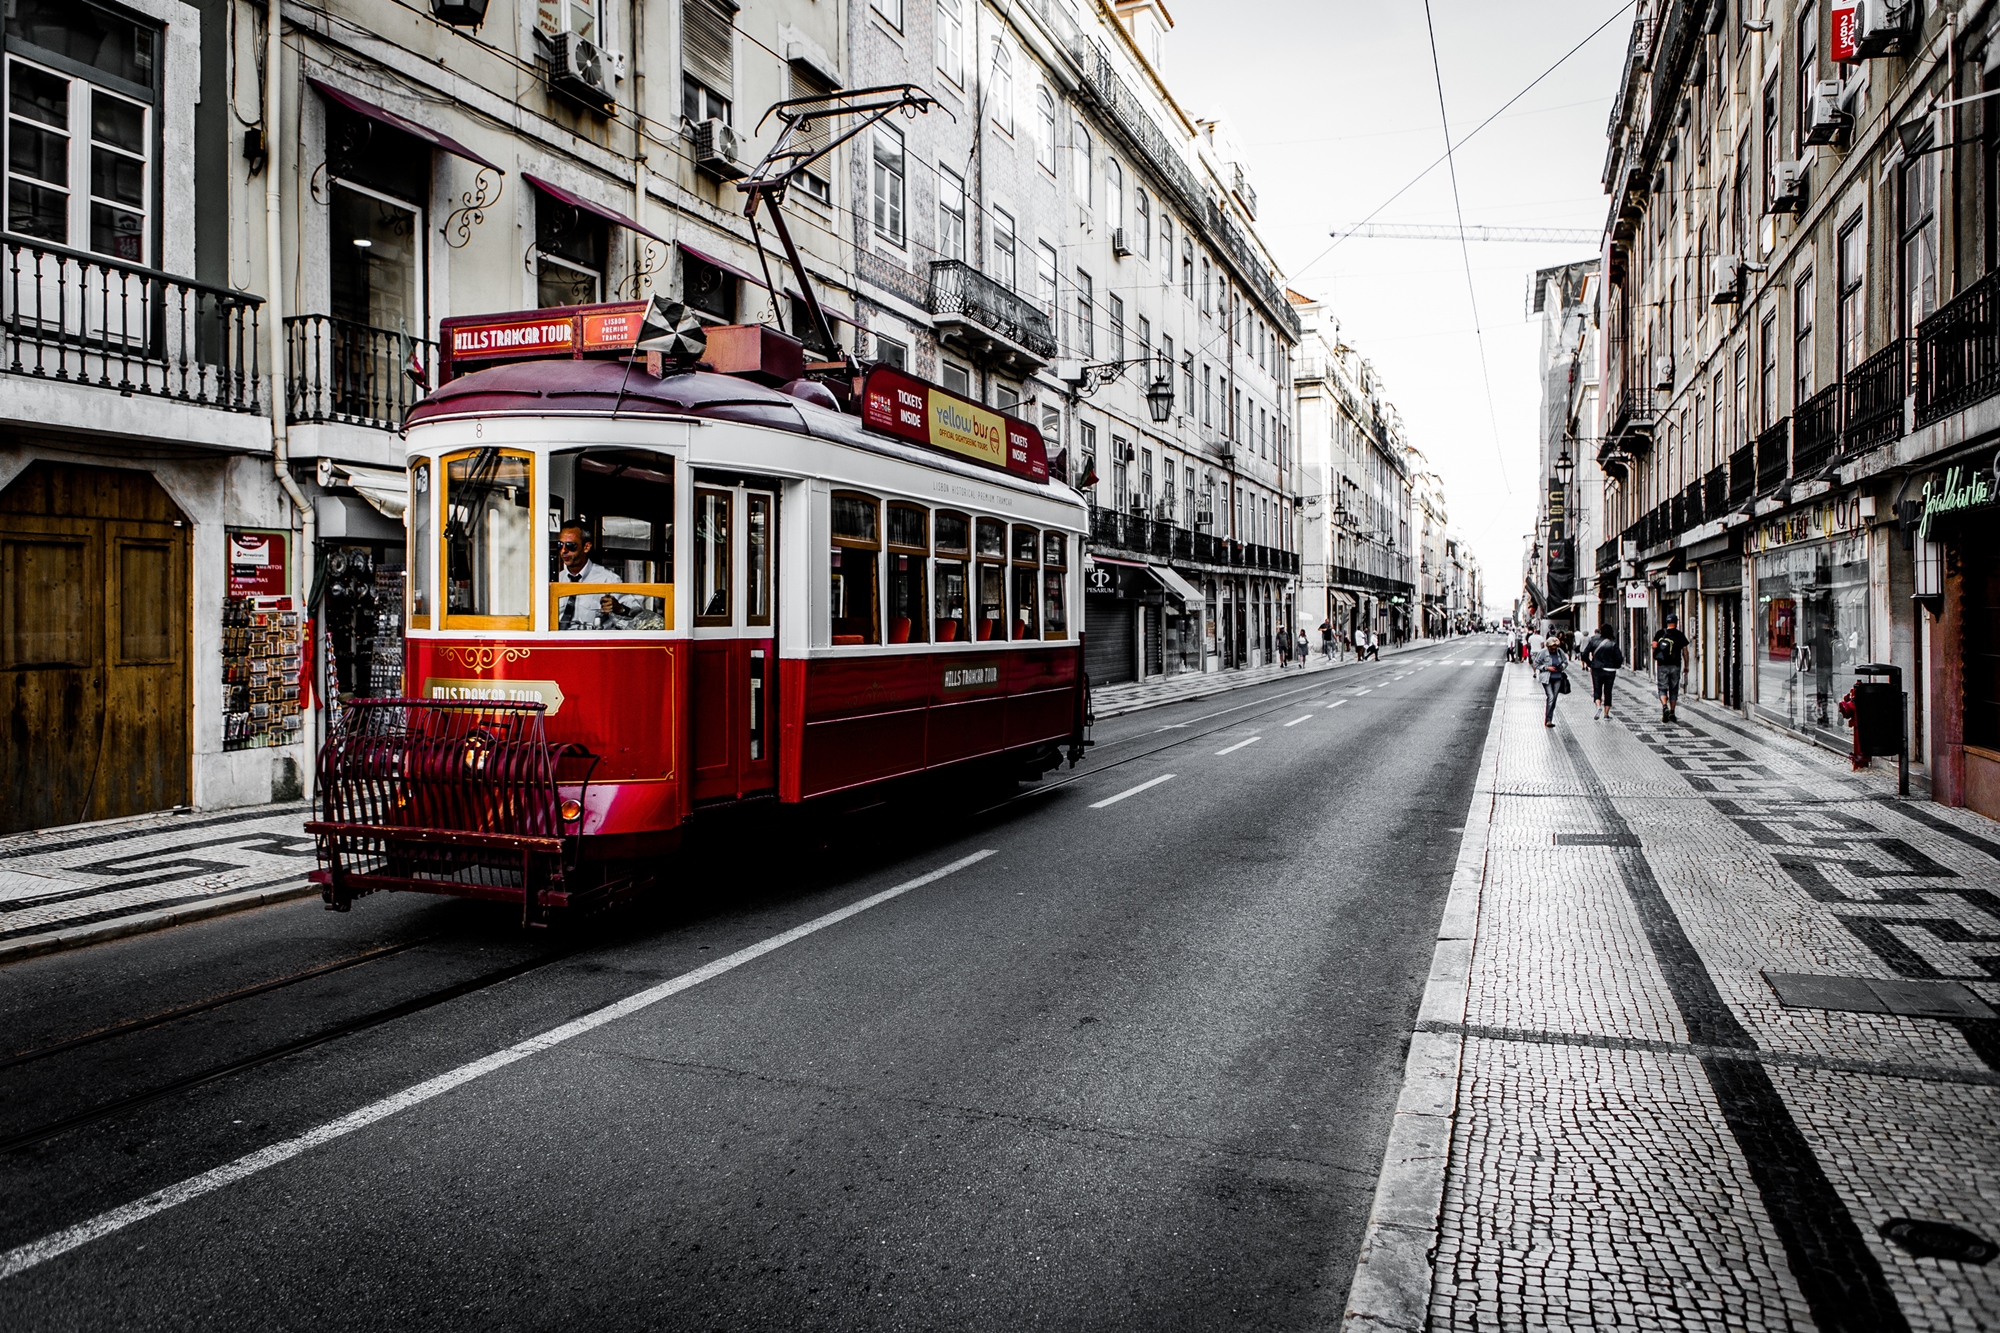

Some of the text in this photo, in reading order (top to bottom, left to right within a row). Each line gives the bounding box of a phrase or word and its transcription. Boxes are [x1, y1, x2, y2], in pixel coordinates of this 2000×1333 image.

[601, 325, 628, 334] PREMIUM
[604, 317, 626, 326] LISBON
[454, 324, 572, 350] HILLS TRAMCAR TOUR
[602, 333, 628, 342] TRAMCAR
[897, 389, 923, 410] TICKETS
[900, 408, 922, 428] INSIDE
[476, 422, 483, 439] 8
[972, 414, 989, 440] bus
[939, 428, 989, 452] OFFICIAL SIGHTSEEING TOURS
[1010, 432, 1028, 449] TICKETS
[1012, 448, 1027, 463] INSIDE
[945, 670, 962, 687] HILLS
